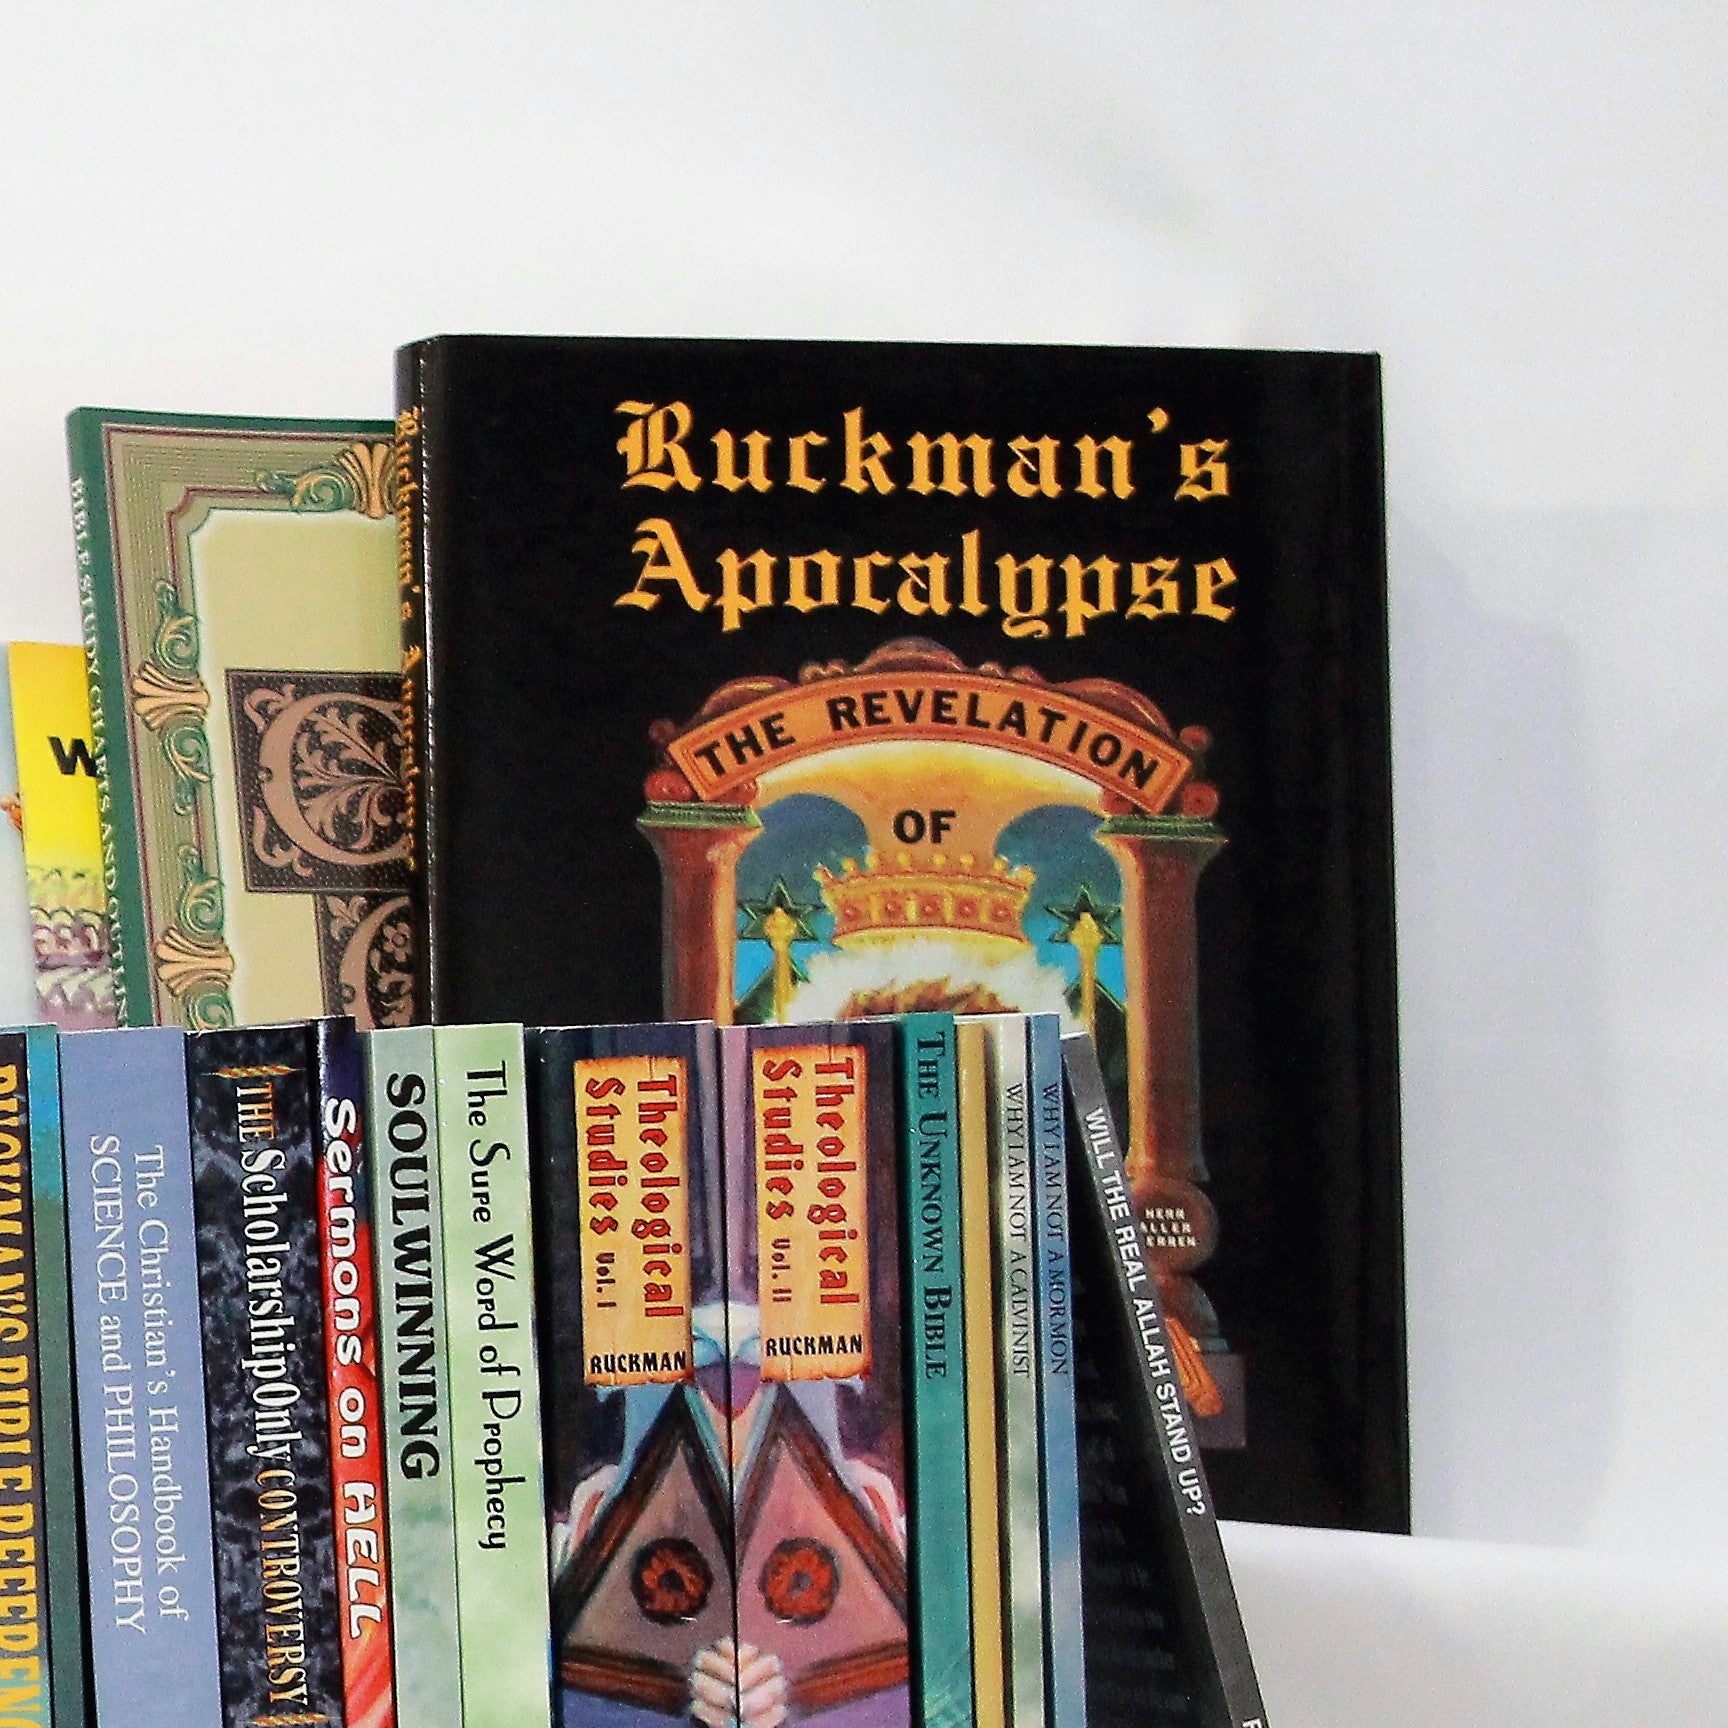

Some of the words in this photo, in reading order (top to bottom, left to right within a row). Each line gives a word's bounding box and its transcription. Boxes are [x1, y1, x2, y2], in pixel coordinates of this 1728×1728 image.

[614, 400, 1232, 501] Ruckman's
[613, 516, 1239, 639] Apocalypse
[695, 710, 796, 778] THE
[827, 688, 1161, 788] REVELATION
[893, 809, 957, 843] OF
[466, 1061, 507, 1127] The
[585, 1078, 628, 1235] Studies
[1083, 1105, 1114, 1170] WILL
[468, 1139, 512, 1223] Sure
[632, 1074, 684, 1318] Theological
[1104, 1170, 1129, 1223] THE
[324, 1098, 364, 1367] Sermons
[1115, 1227, 1147, 1291] REAL
[387, 1073, 439, 1480] SOULWINNING
[473, 1234, 518, 1331] Word
[478, 1345, 521, 1377] of
[590, 1352, 686, 1374] RUCKMAN
[1133, 1299, 1170, 1381] ALLAH
[335, 1387, 364, 1457] on
[1156, 1385, 1191, 1472] STAND
[480, 1389, 525, 1551] Prophecy
[1177, 1468, 1205, 1515] UP?
[340, 1483, 382, 1640] HELL
